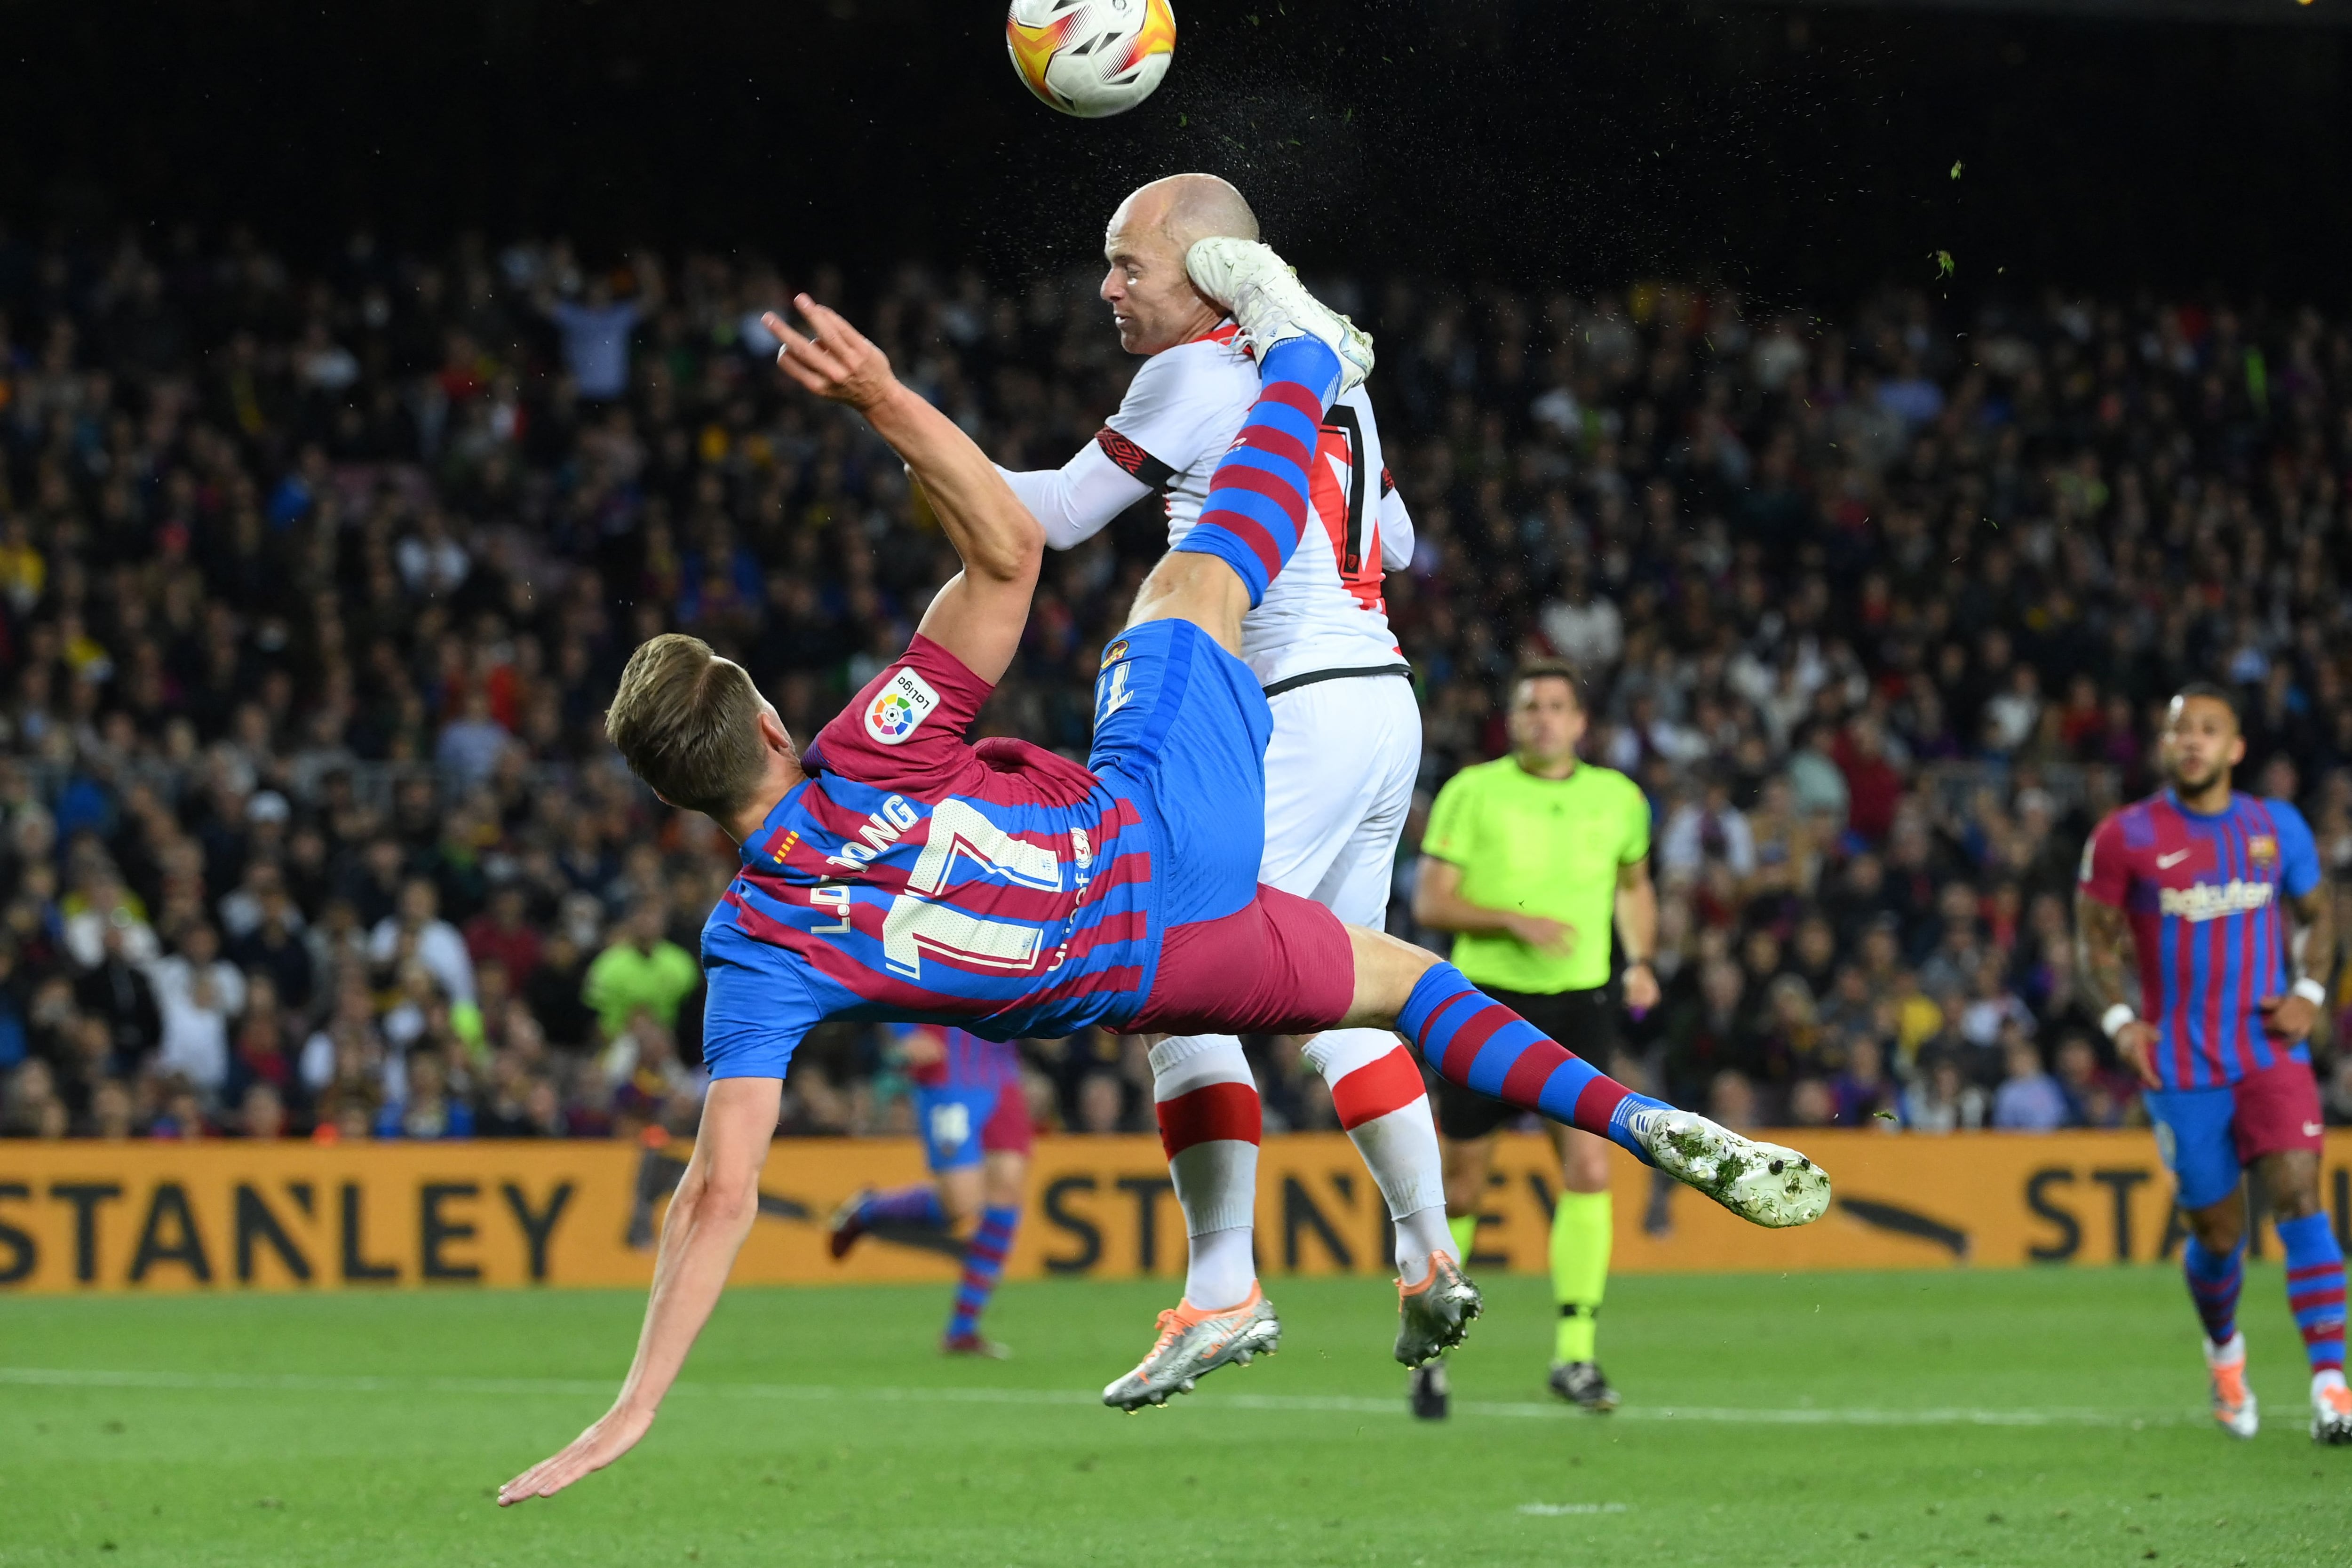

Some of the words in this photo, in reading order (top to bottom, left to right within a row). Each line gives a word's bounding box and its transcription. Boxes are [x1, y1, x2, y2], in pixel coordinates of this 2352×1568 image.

[1319, 405, 1365, 581] 7
[897, 676, 930, 709] LaLiga
[882, 798, 1063, 980] 17
[0, 1181, 575, 1282] STANLEY
